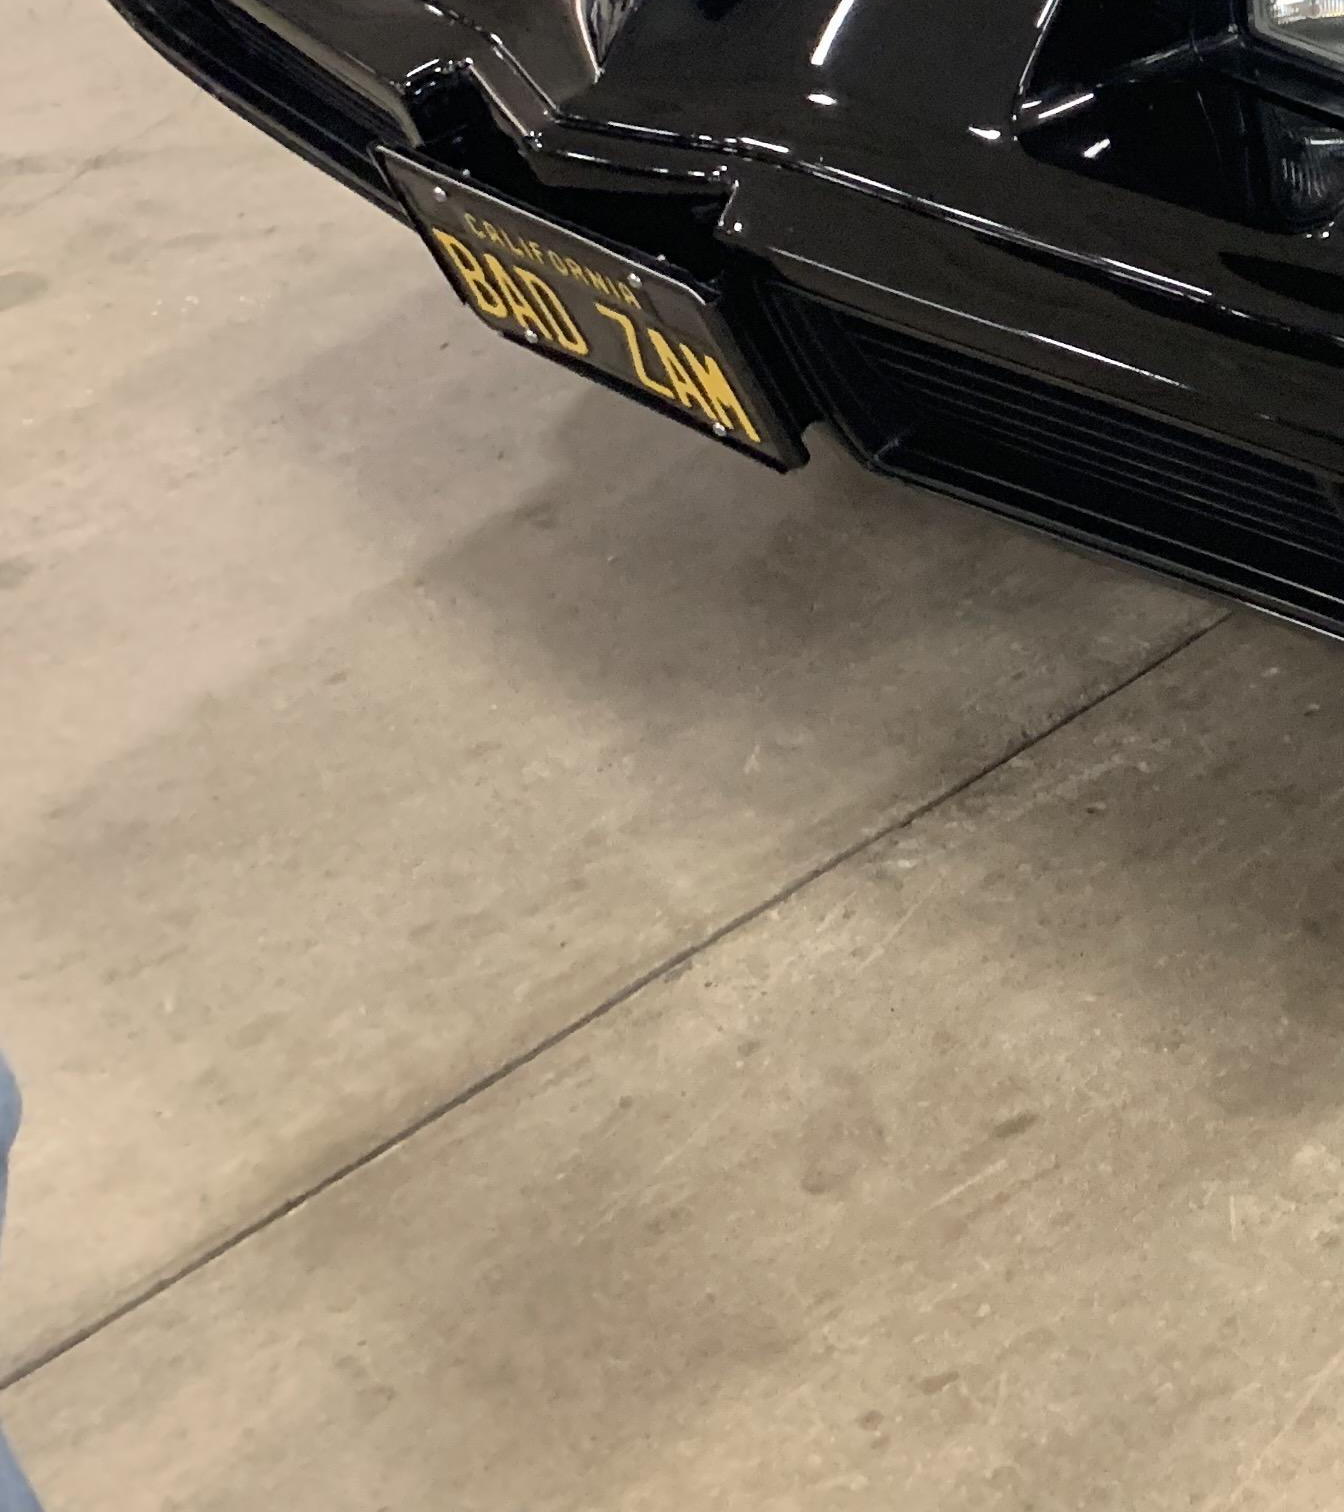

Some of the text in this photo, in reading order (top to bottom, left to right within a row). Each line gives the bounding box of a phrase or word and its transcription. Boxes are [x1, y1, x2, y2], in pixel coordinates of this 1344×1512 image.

[432, 226, 761, 443] BAD ZAM
[463, 211, 642, 310] CALIFORNIA
